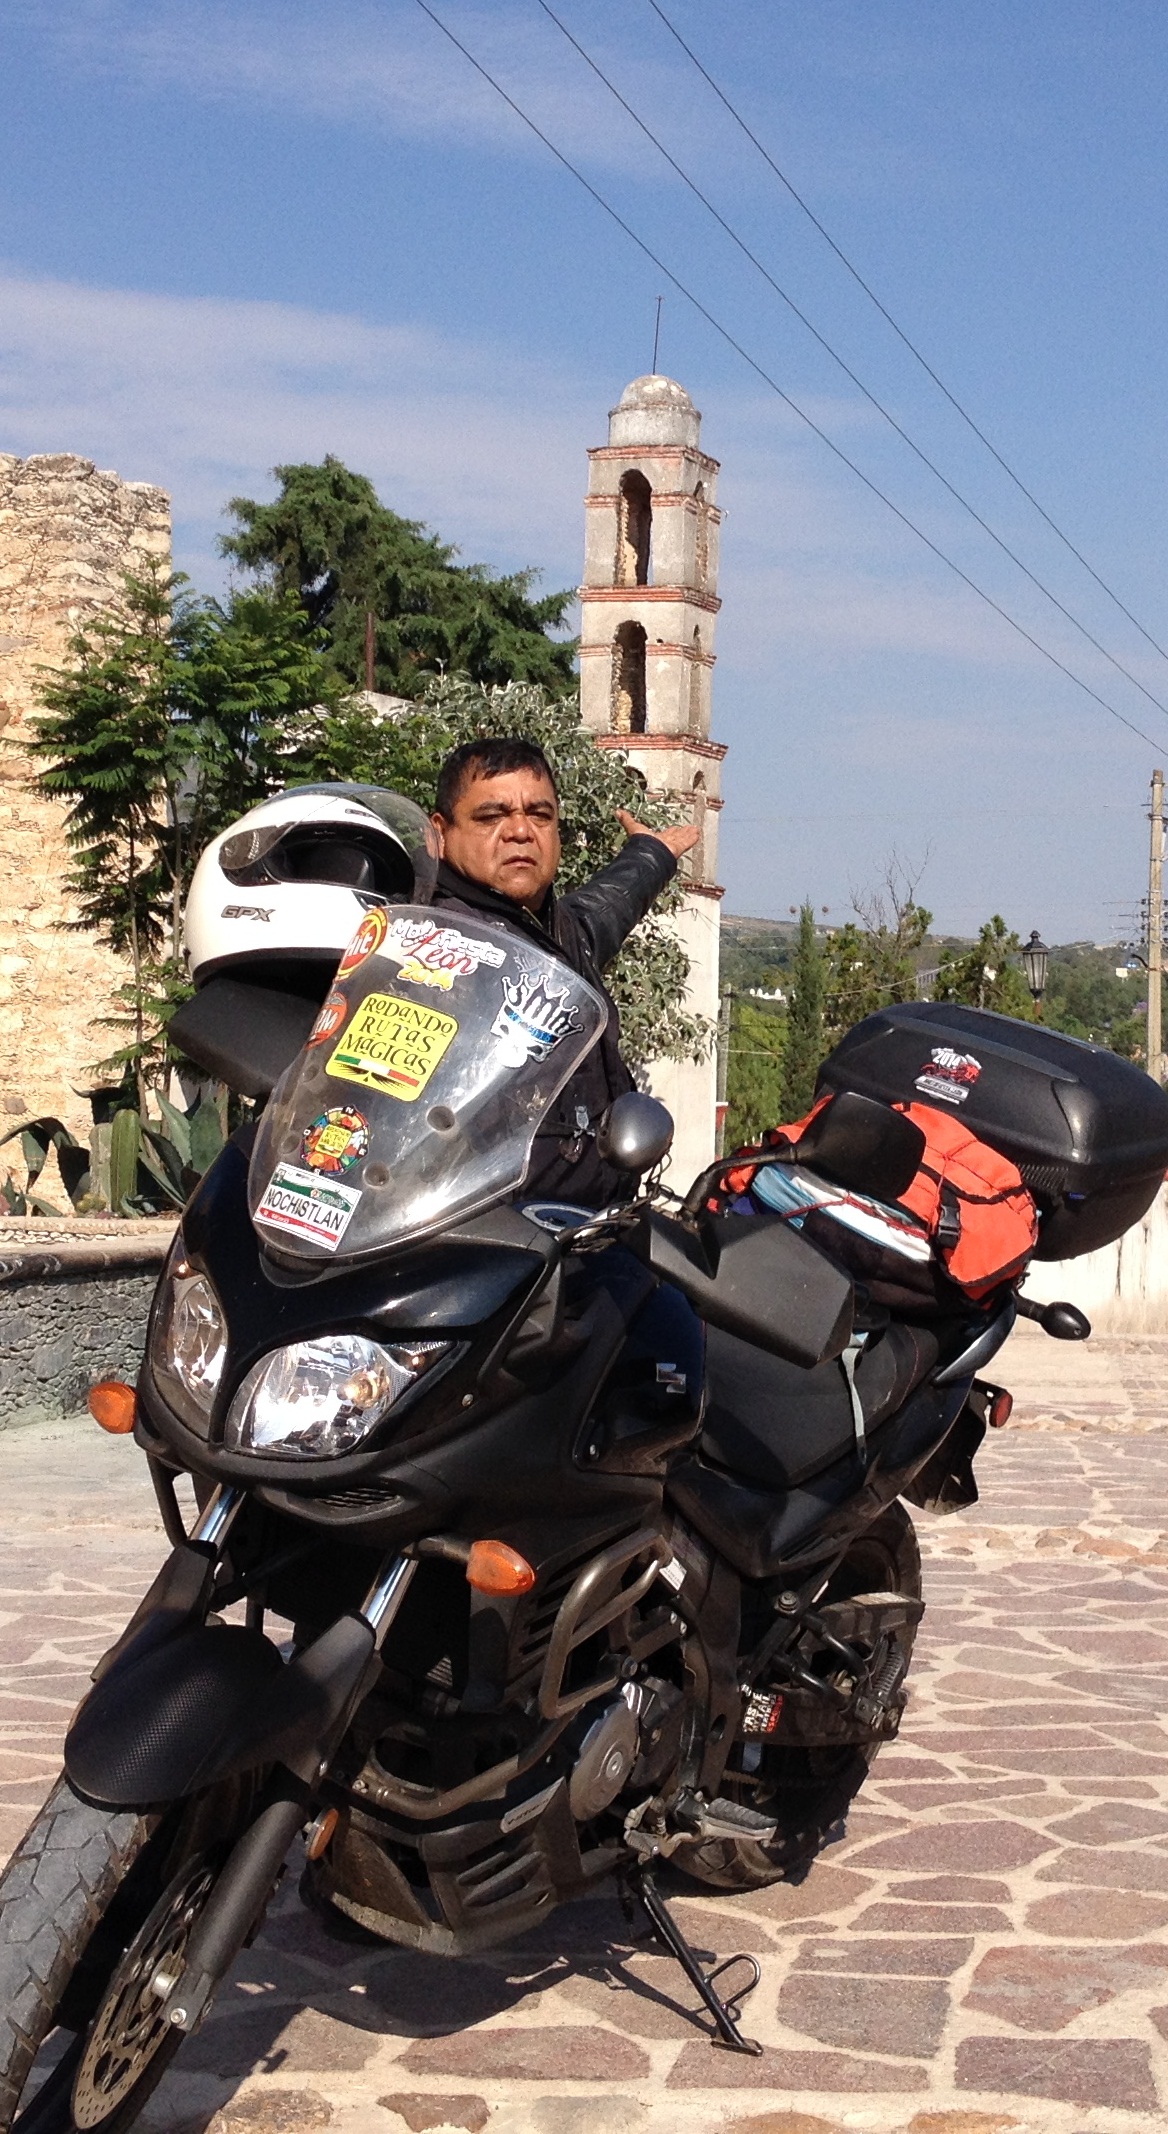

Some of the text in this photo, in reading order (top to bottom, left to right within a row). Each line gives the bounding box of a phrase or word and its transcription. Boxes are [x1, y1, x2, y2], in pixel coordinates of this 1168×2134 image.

[221, 905, 276, 922] GPX
[932, 1050, 962, 1069] 2014
[264, 1187, 345, 1231] NOCHISTLAN
